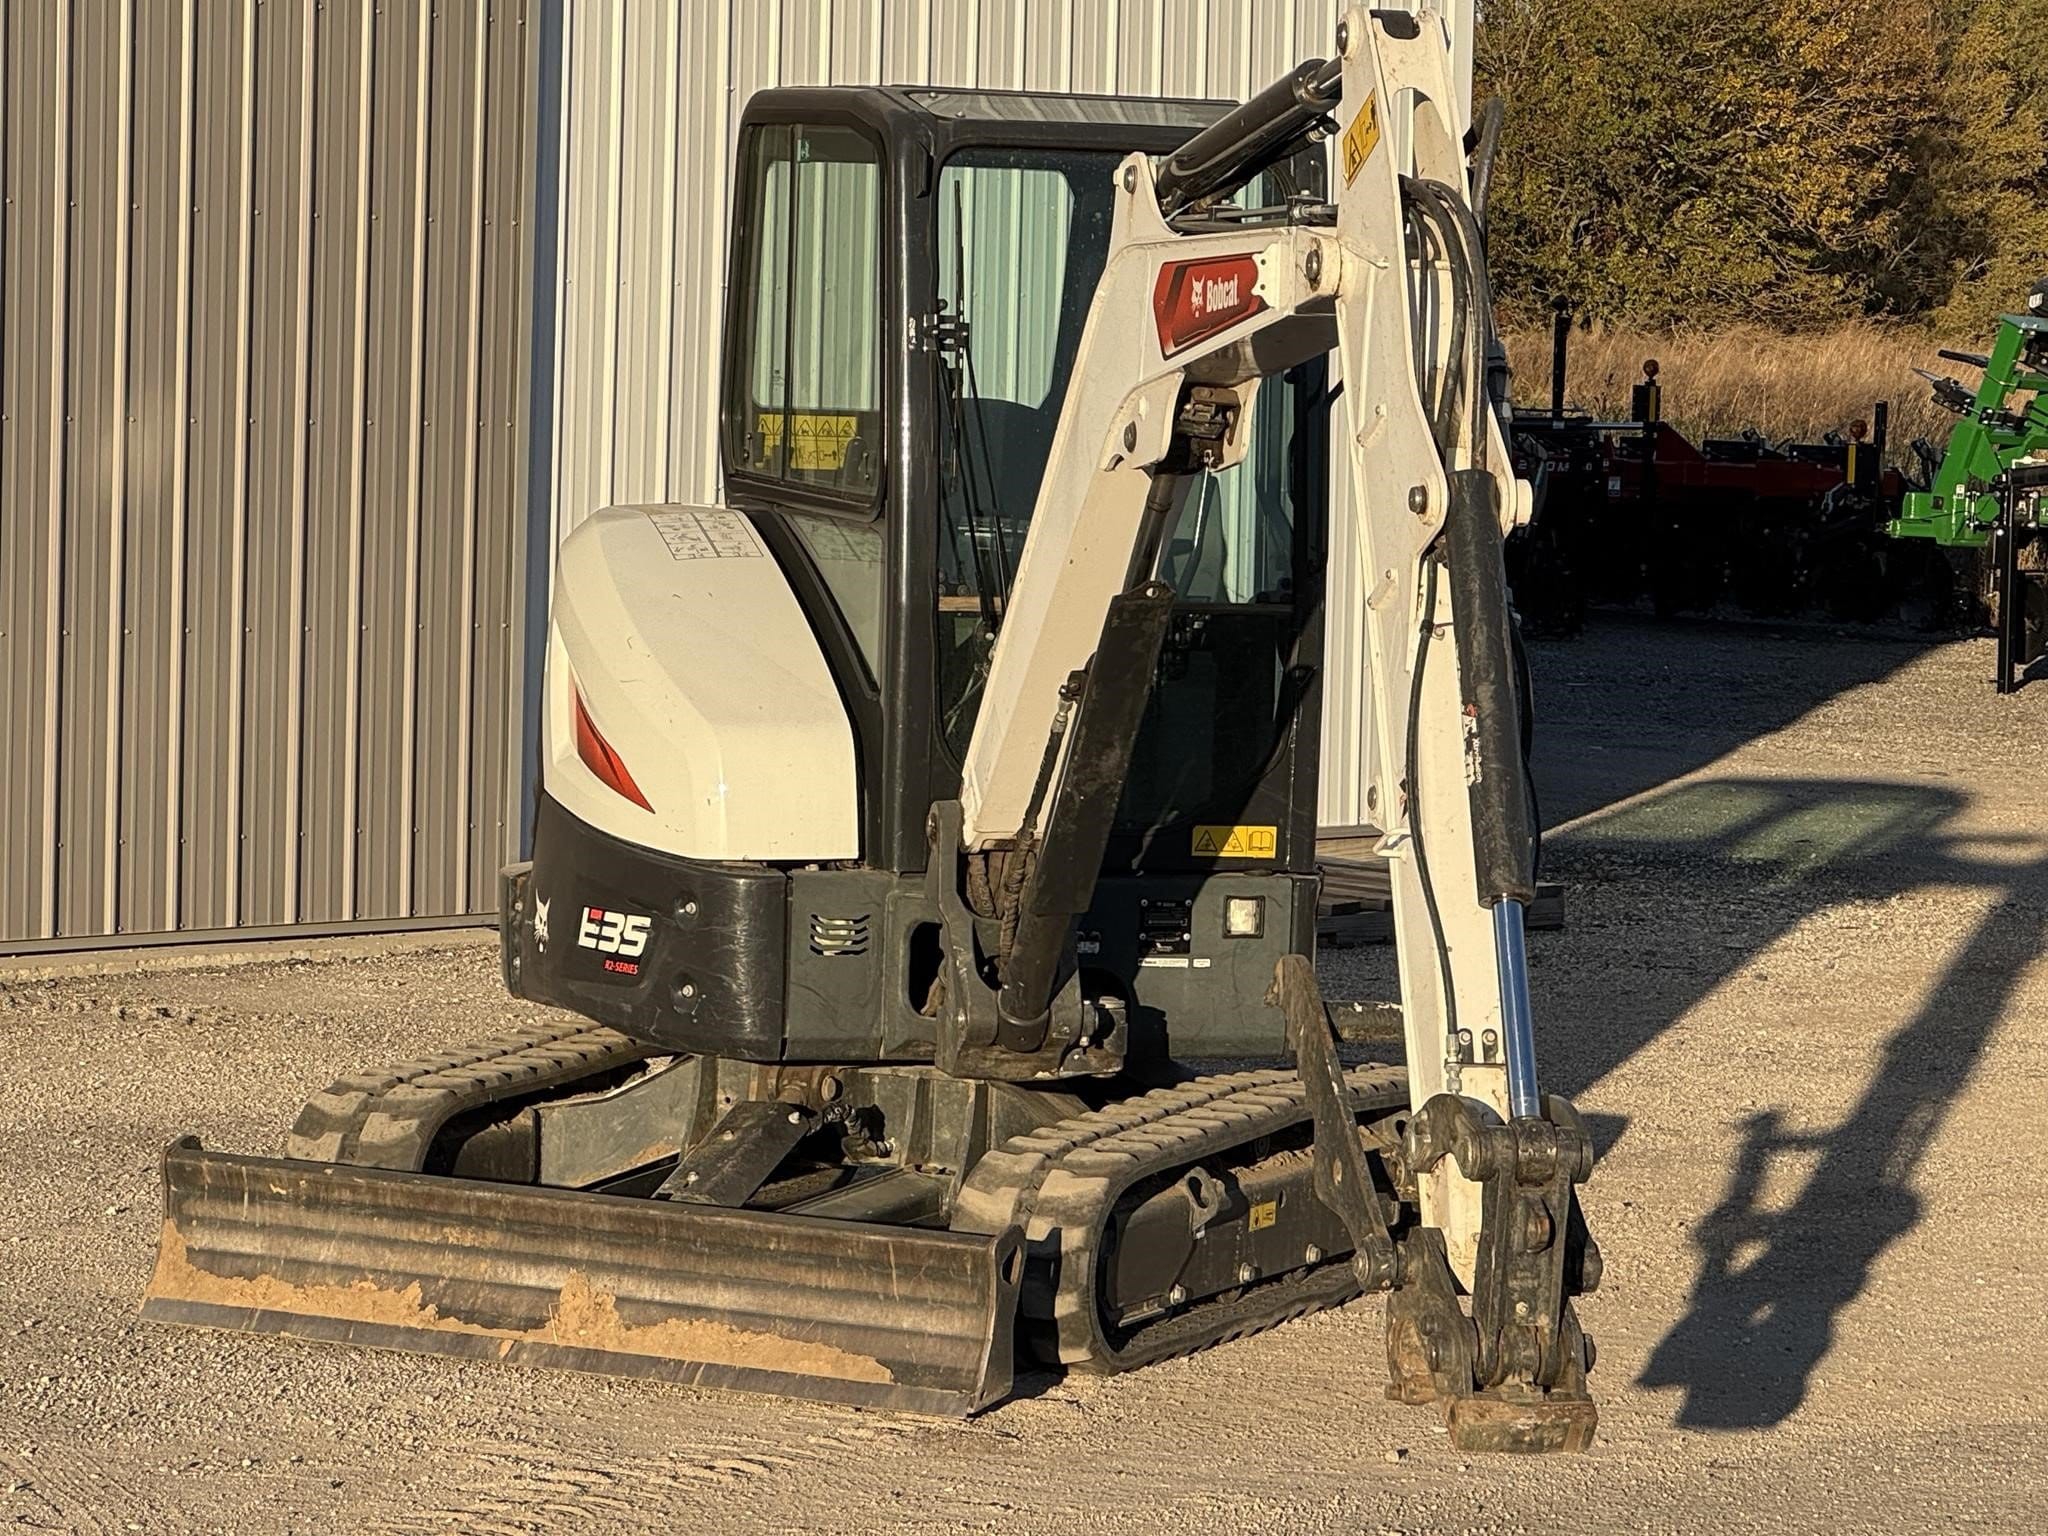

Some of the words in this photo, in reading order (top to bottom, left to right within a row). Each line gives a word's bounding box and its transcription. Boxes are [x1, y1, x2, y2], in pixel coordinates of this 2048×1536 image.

[1206, 273, 1238, 312] Bobcat
[578, 906, 651, 957] E35
[604, 959, 639, 975] R2-SERIES
